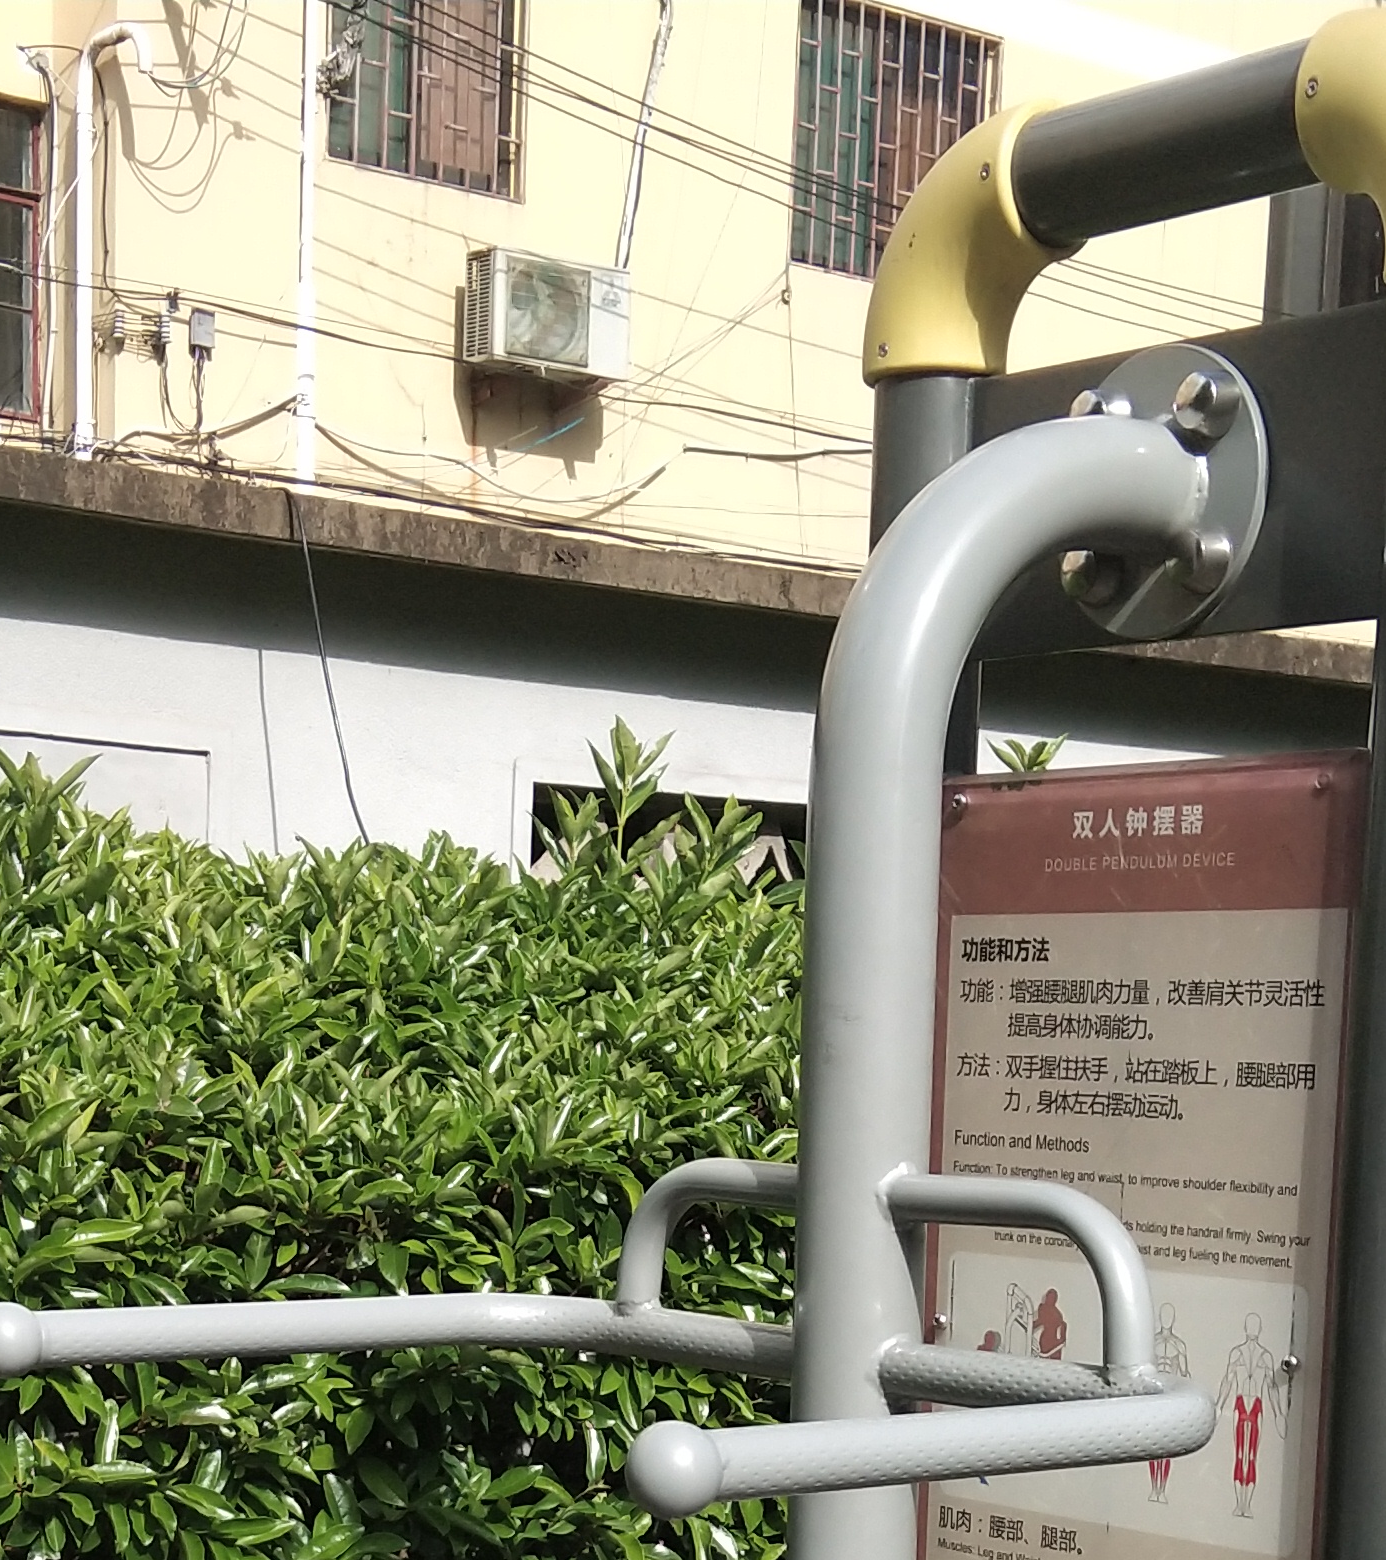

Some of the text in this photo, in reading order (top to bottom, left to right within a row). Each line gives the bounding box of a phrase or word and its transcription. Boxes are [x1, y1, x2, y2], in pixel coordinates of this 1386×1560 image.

[1072, 804, 1205, 840] 双人钟摆器
[1045, 851, 1236, 872] DOUBLE PENDULUM DEVICE
[961, 937, 1050, 963] 功能和方法
[1007, 1012, 1155, 1042] 提高身体协调能力。
[1003, 1089, 1185, 1121] 力，身体左右摆动运动。
[954, 1129, 1090, 1154] Function and Methods
[996, 1163, 1008, 1176] To
[1010, 1166, 1059, 1181] strengthen
[1060, 1168, 1075, 1183] leg
[1077, 1171, 1095, 1183] and
[1128, 1174, 1138, 1185] to
[1140, 1175, 1180, 1189] improve
[1182, 1177, 1227, 1192] shoulder
[1229, 1180, 1275, 1197] flexibility
[1277, 1184, 1299, 1197] and
[994, 1231, 1079, 1251] trunk on the coronar
[1135, 1220, 1168, 1238] holding
[1170, 1223, 1184, 1236] the
[1186, 1225, 1224, 1239] handrail
[1256, 1229, 1286, 1248] Swing
[1288, 1235, 1312, 1248] your
[1153, 1244, 1170, 1257] and
[1172, 1245, 1187, 1262] leg
[1189, 1247, 1220, 1265] fueling
[1222, 1250, 1237, 1264] the
[938, 1505, 1083, 1556] 肌肉：腰部、腿部。
